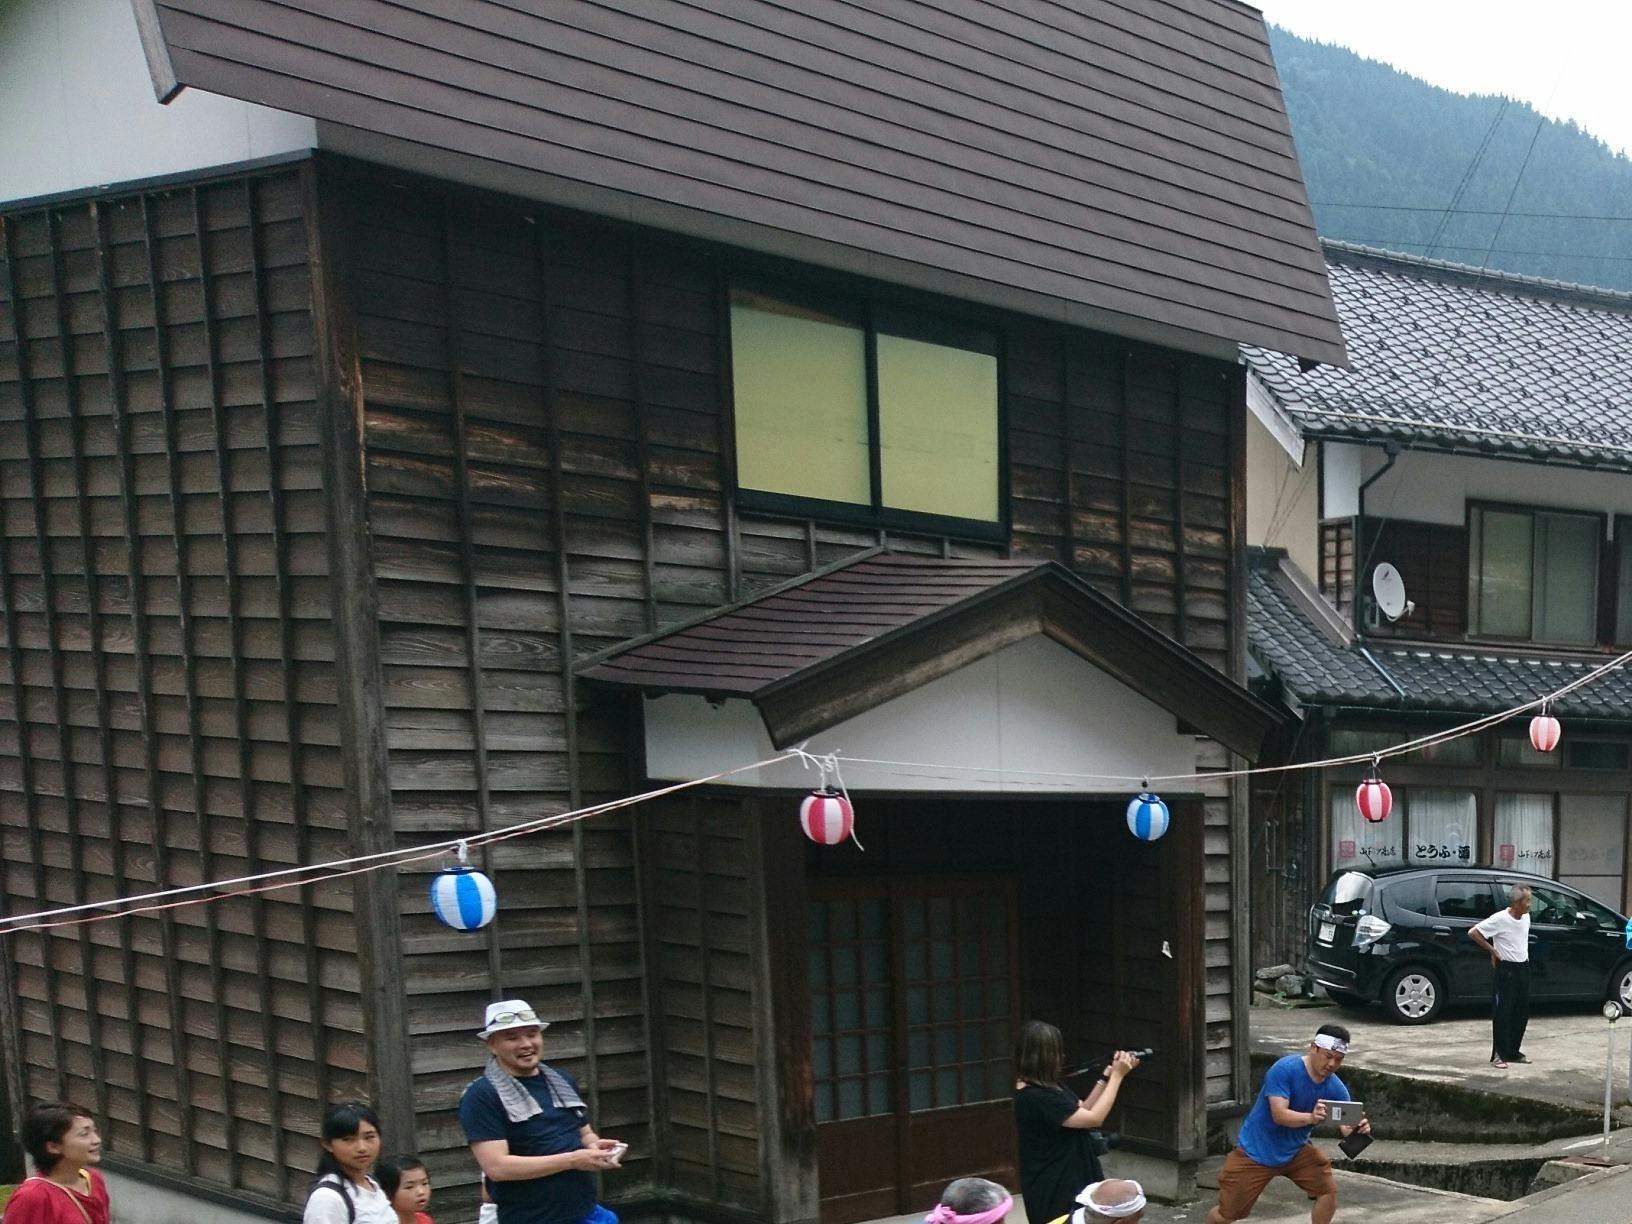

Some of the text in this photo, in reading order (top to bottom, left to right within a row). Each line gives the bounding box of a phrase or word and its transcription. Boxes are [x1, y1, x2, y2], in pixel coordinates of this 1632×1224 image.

[1416, 844, 1470, 860] とうふ・酒
